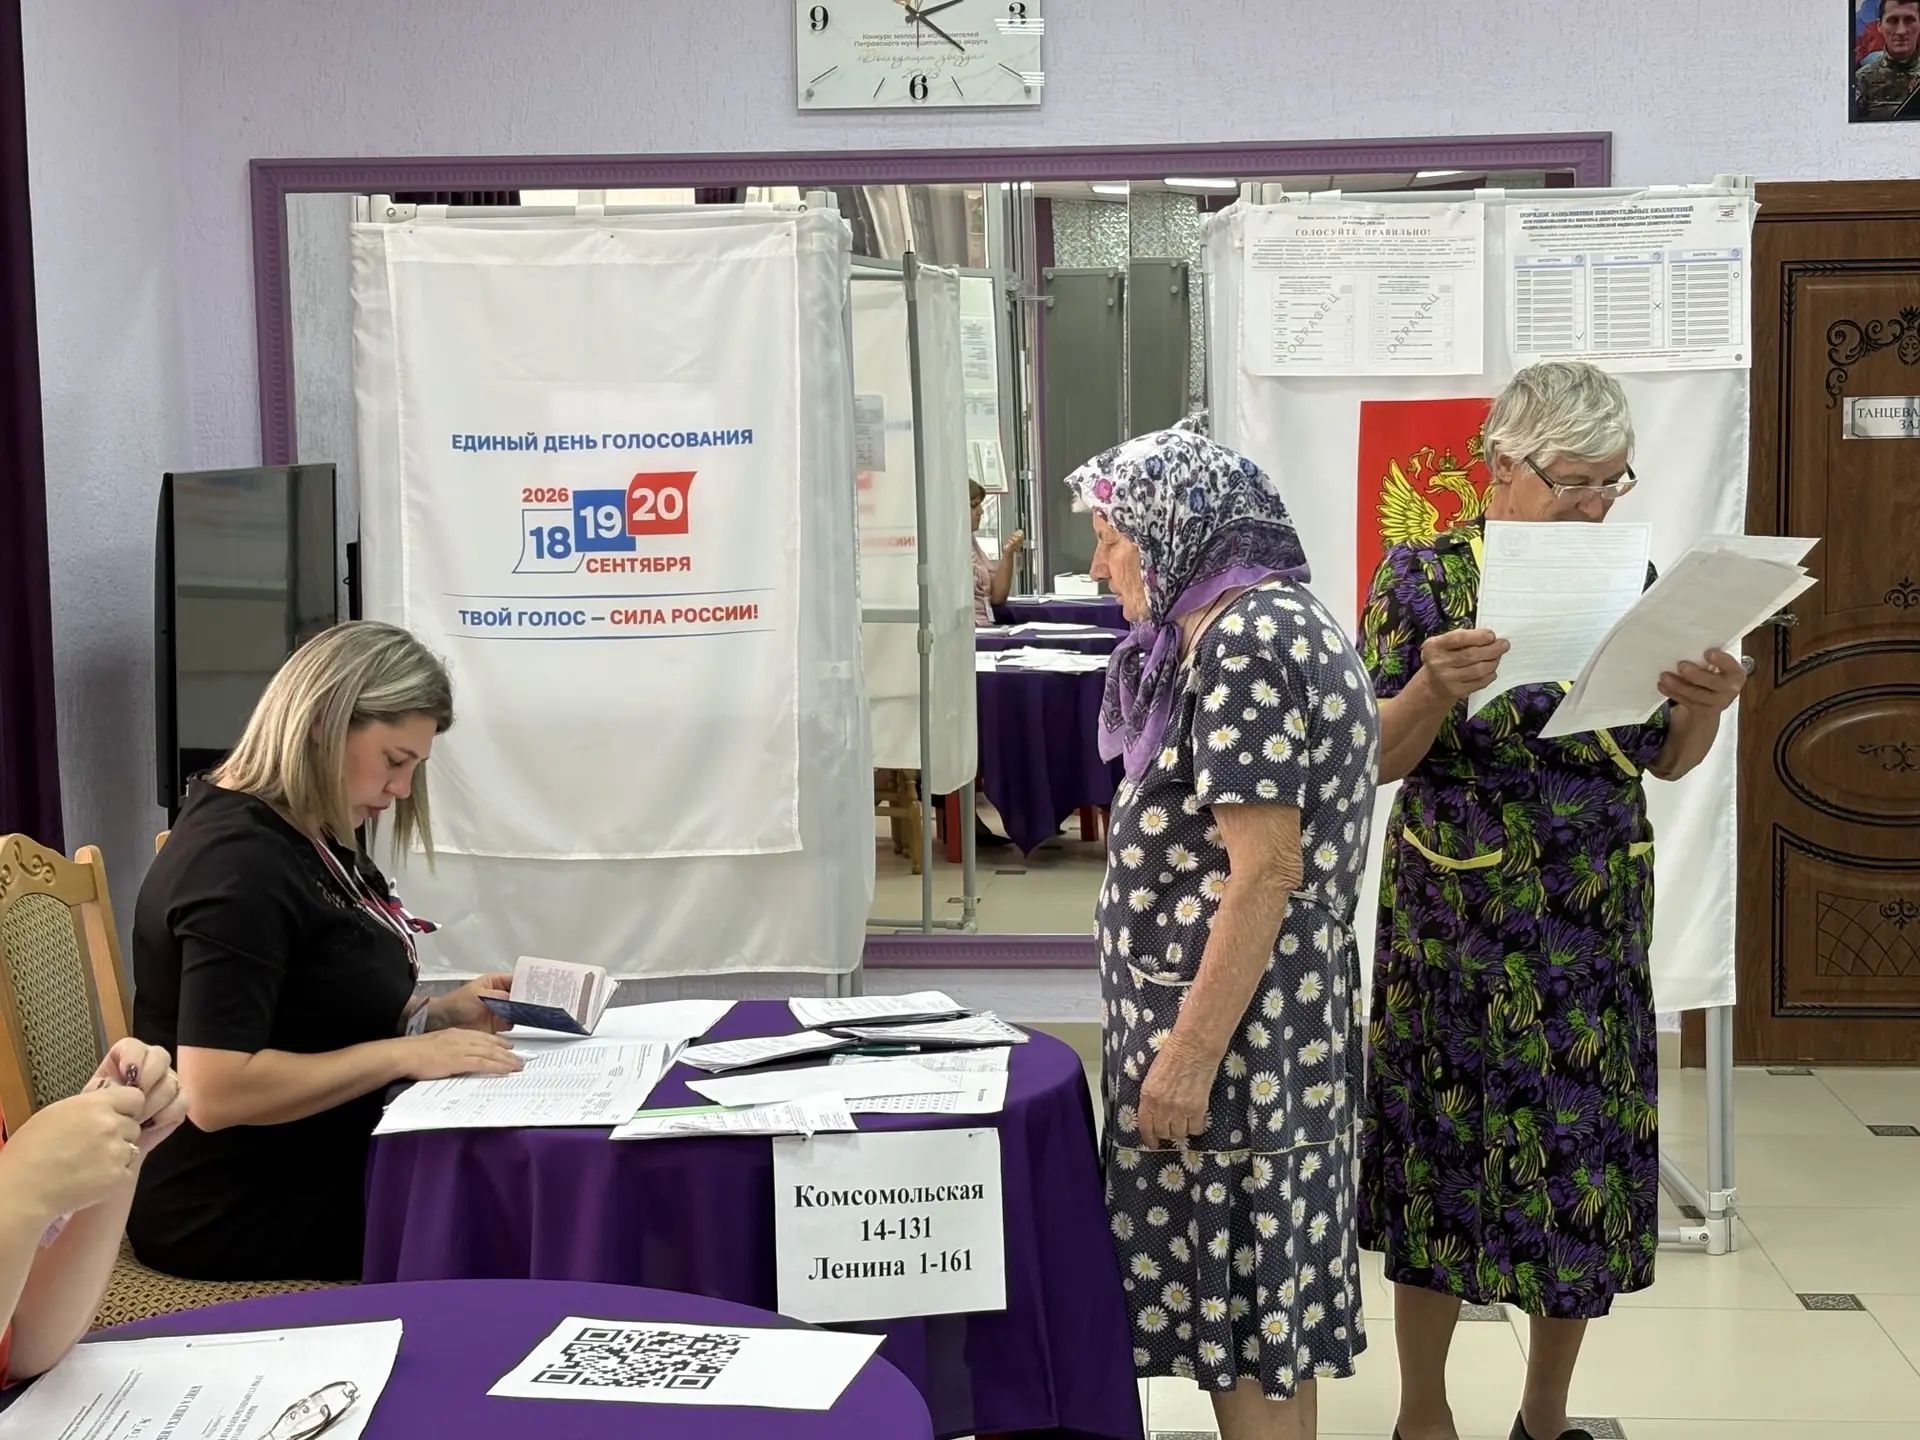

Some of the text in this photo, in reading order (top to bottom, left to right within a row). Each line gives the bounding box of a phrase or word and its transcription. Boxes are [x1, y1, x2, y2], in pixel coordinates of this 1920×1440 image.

[810, 5, 829, 31] 9
[1008, 2, 1027, 24] 3
[863, 33, 892, 41] Конкурс
[909, 74, 928, 101] 6
[1295, 228, 1431, 236] ГОЛОСУЙТЕ ПРАВИЛЬНО!
[1287, 294, 1340, 353] ОБРАЗЕЦ
[1387, 293, 1440, 353] ОБРАЗЕЦ
[1856, 407, 1920, 419] ТАНЦЕВА
[452, 429, 753, 453] ЕДИНЫЙ ДЕНЬ ГОЛОСОВАНИЯ
[522, 488, 569, 503] 2026
[632, 487, 683, 521] 20
[580, 505, 622, 539] 19
[530, 526, 571, 559] 18
[586, 556, 691, 573] СЕНТЯБРЯ
[459, 608, 512, 626] ТВОЙ
[518, 609, 586, 626] ГОЛОС
[610, 608, 666, 626] СИЛА
[672, 604, 759, 624] РОССИИ!
[793, 1183, 984, 1208] Комсомольская
[861, 1216, 931, 1241] 14-131
[808, 1249, 972, 1280] Ленина 1-161
